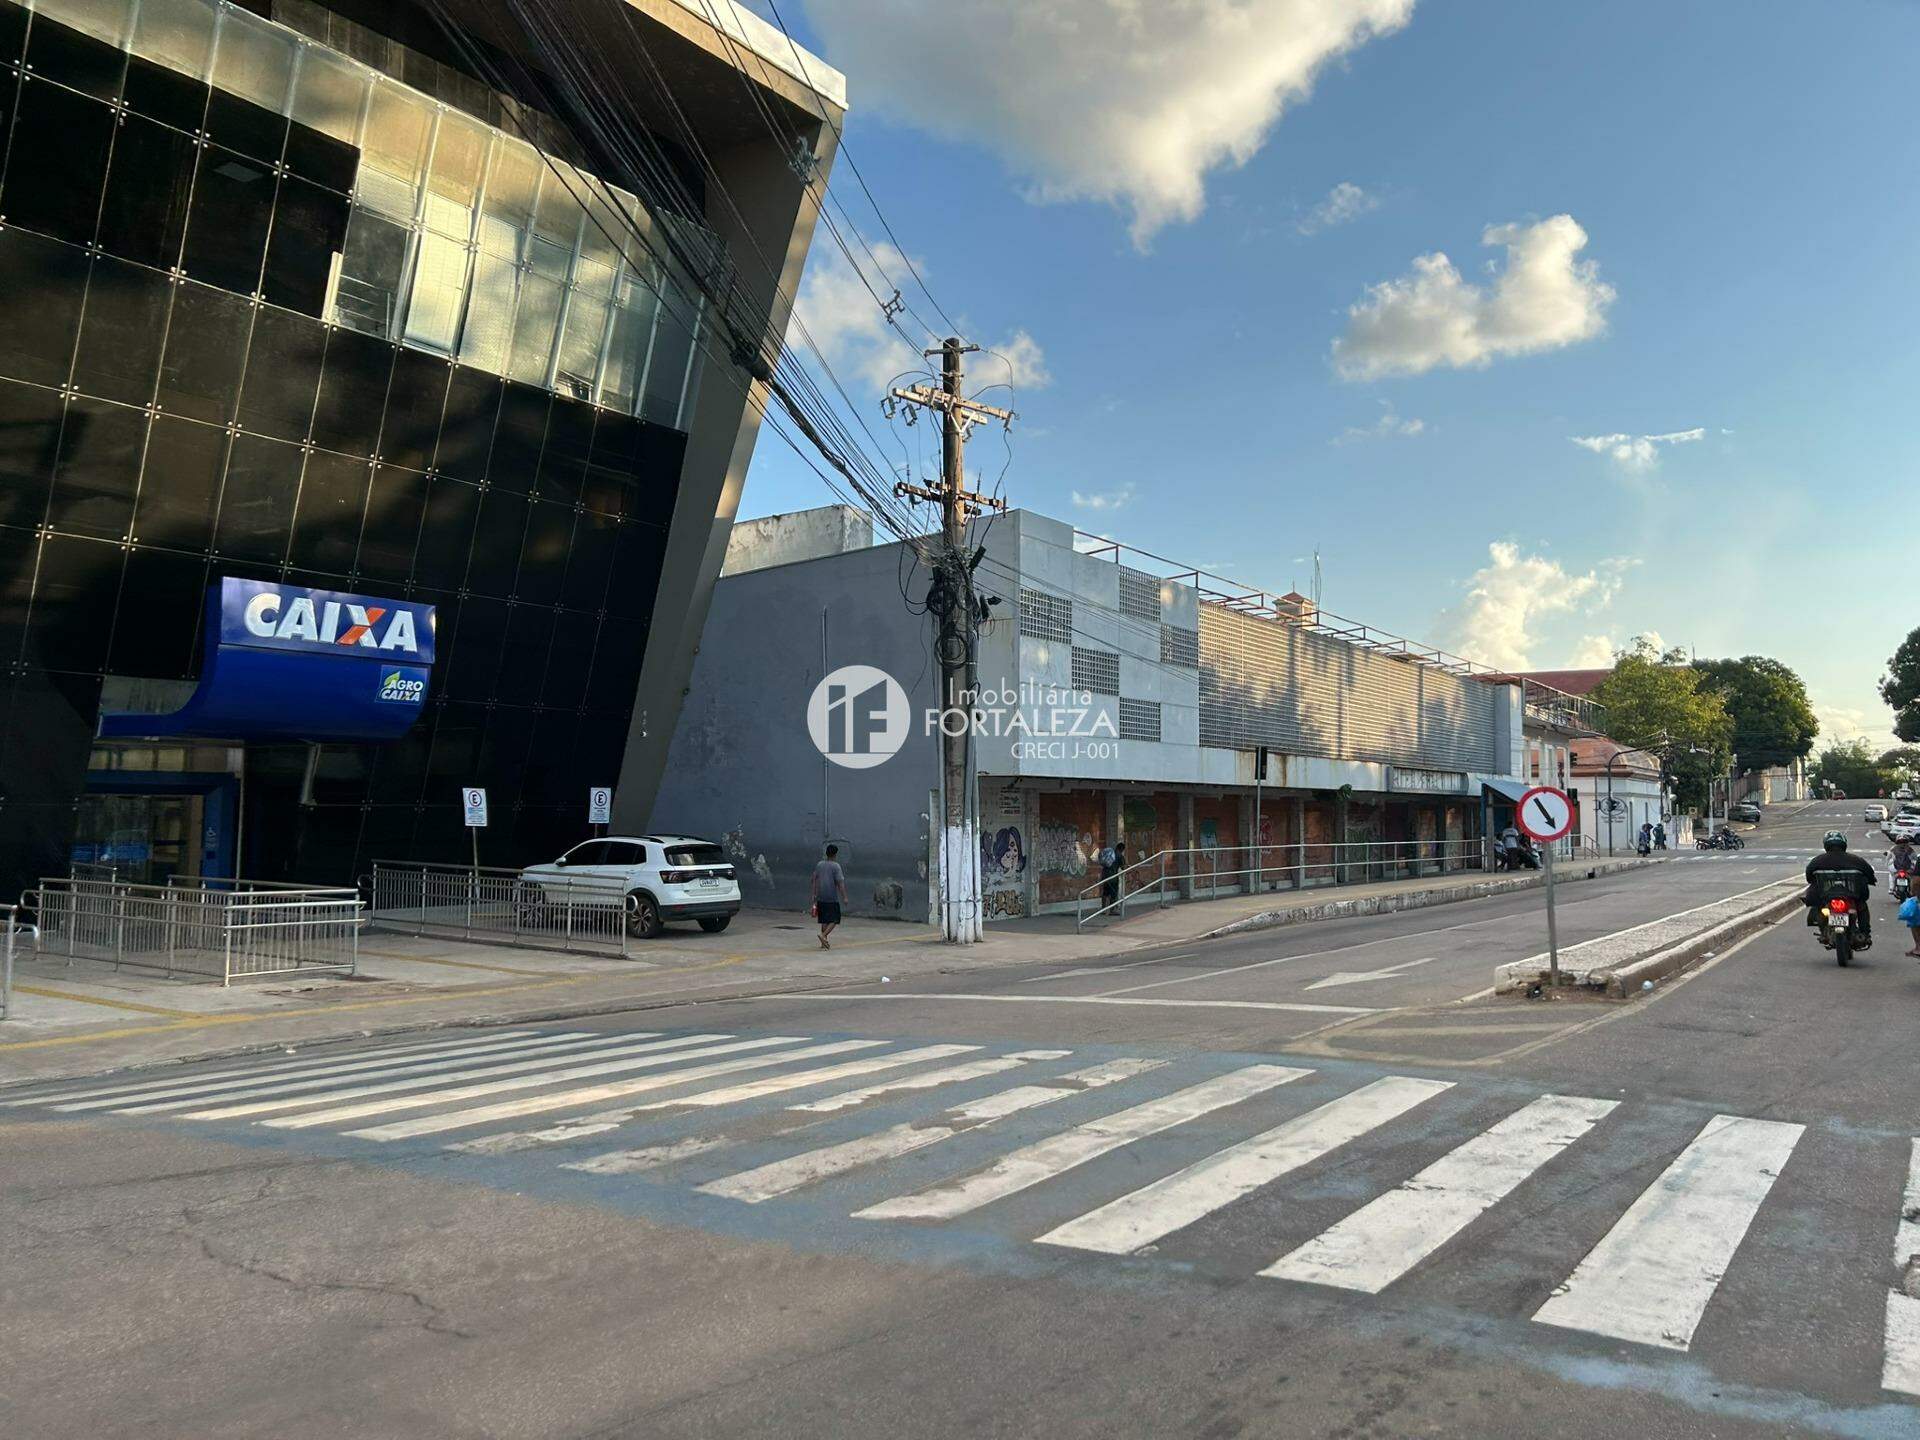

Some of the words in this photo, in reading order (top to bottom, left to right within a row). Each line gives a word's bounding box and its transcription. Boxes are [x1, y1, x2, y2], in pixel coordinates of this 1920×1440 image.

[245, 592, 418, 653] CAIXA
[388, 680, 423, 690] AGRO
[381, 690, 421, 701] CAIXA
[472, 794, 478, 804] E
[598, 794, 604, 804] E
